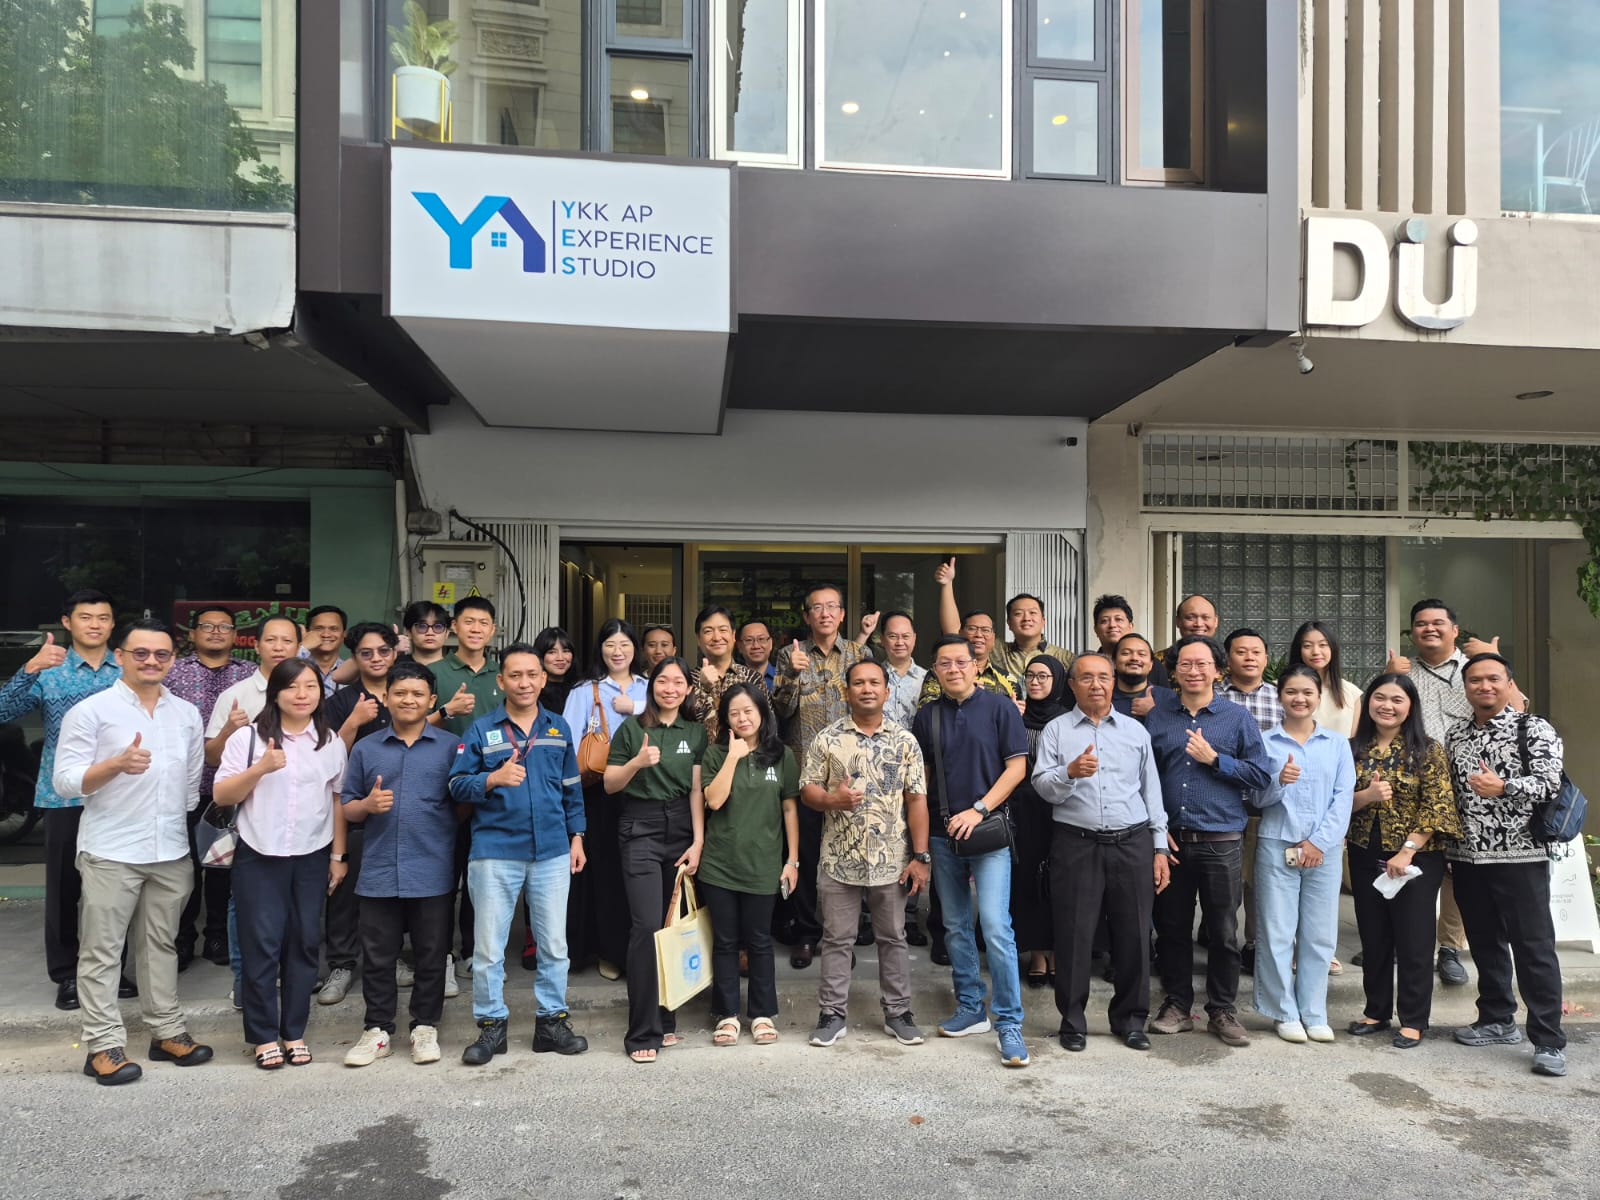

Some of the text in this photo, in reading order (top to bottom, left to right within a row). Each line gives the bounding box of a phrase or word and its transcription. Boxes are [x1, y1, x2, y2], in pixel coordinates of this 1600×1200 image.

[561, 200, 653, 223] YKK AP
[561, 228, 713, 255] EXPERIENCE
[561, 257, 656, 280] STUDIO
